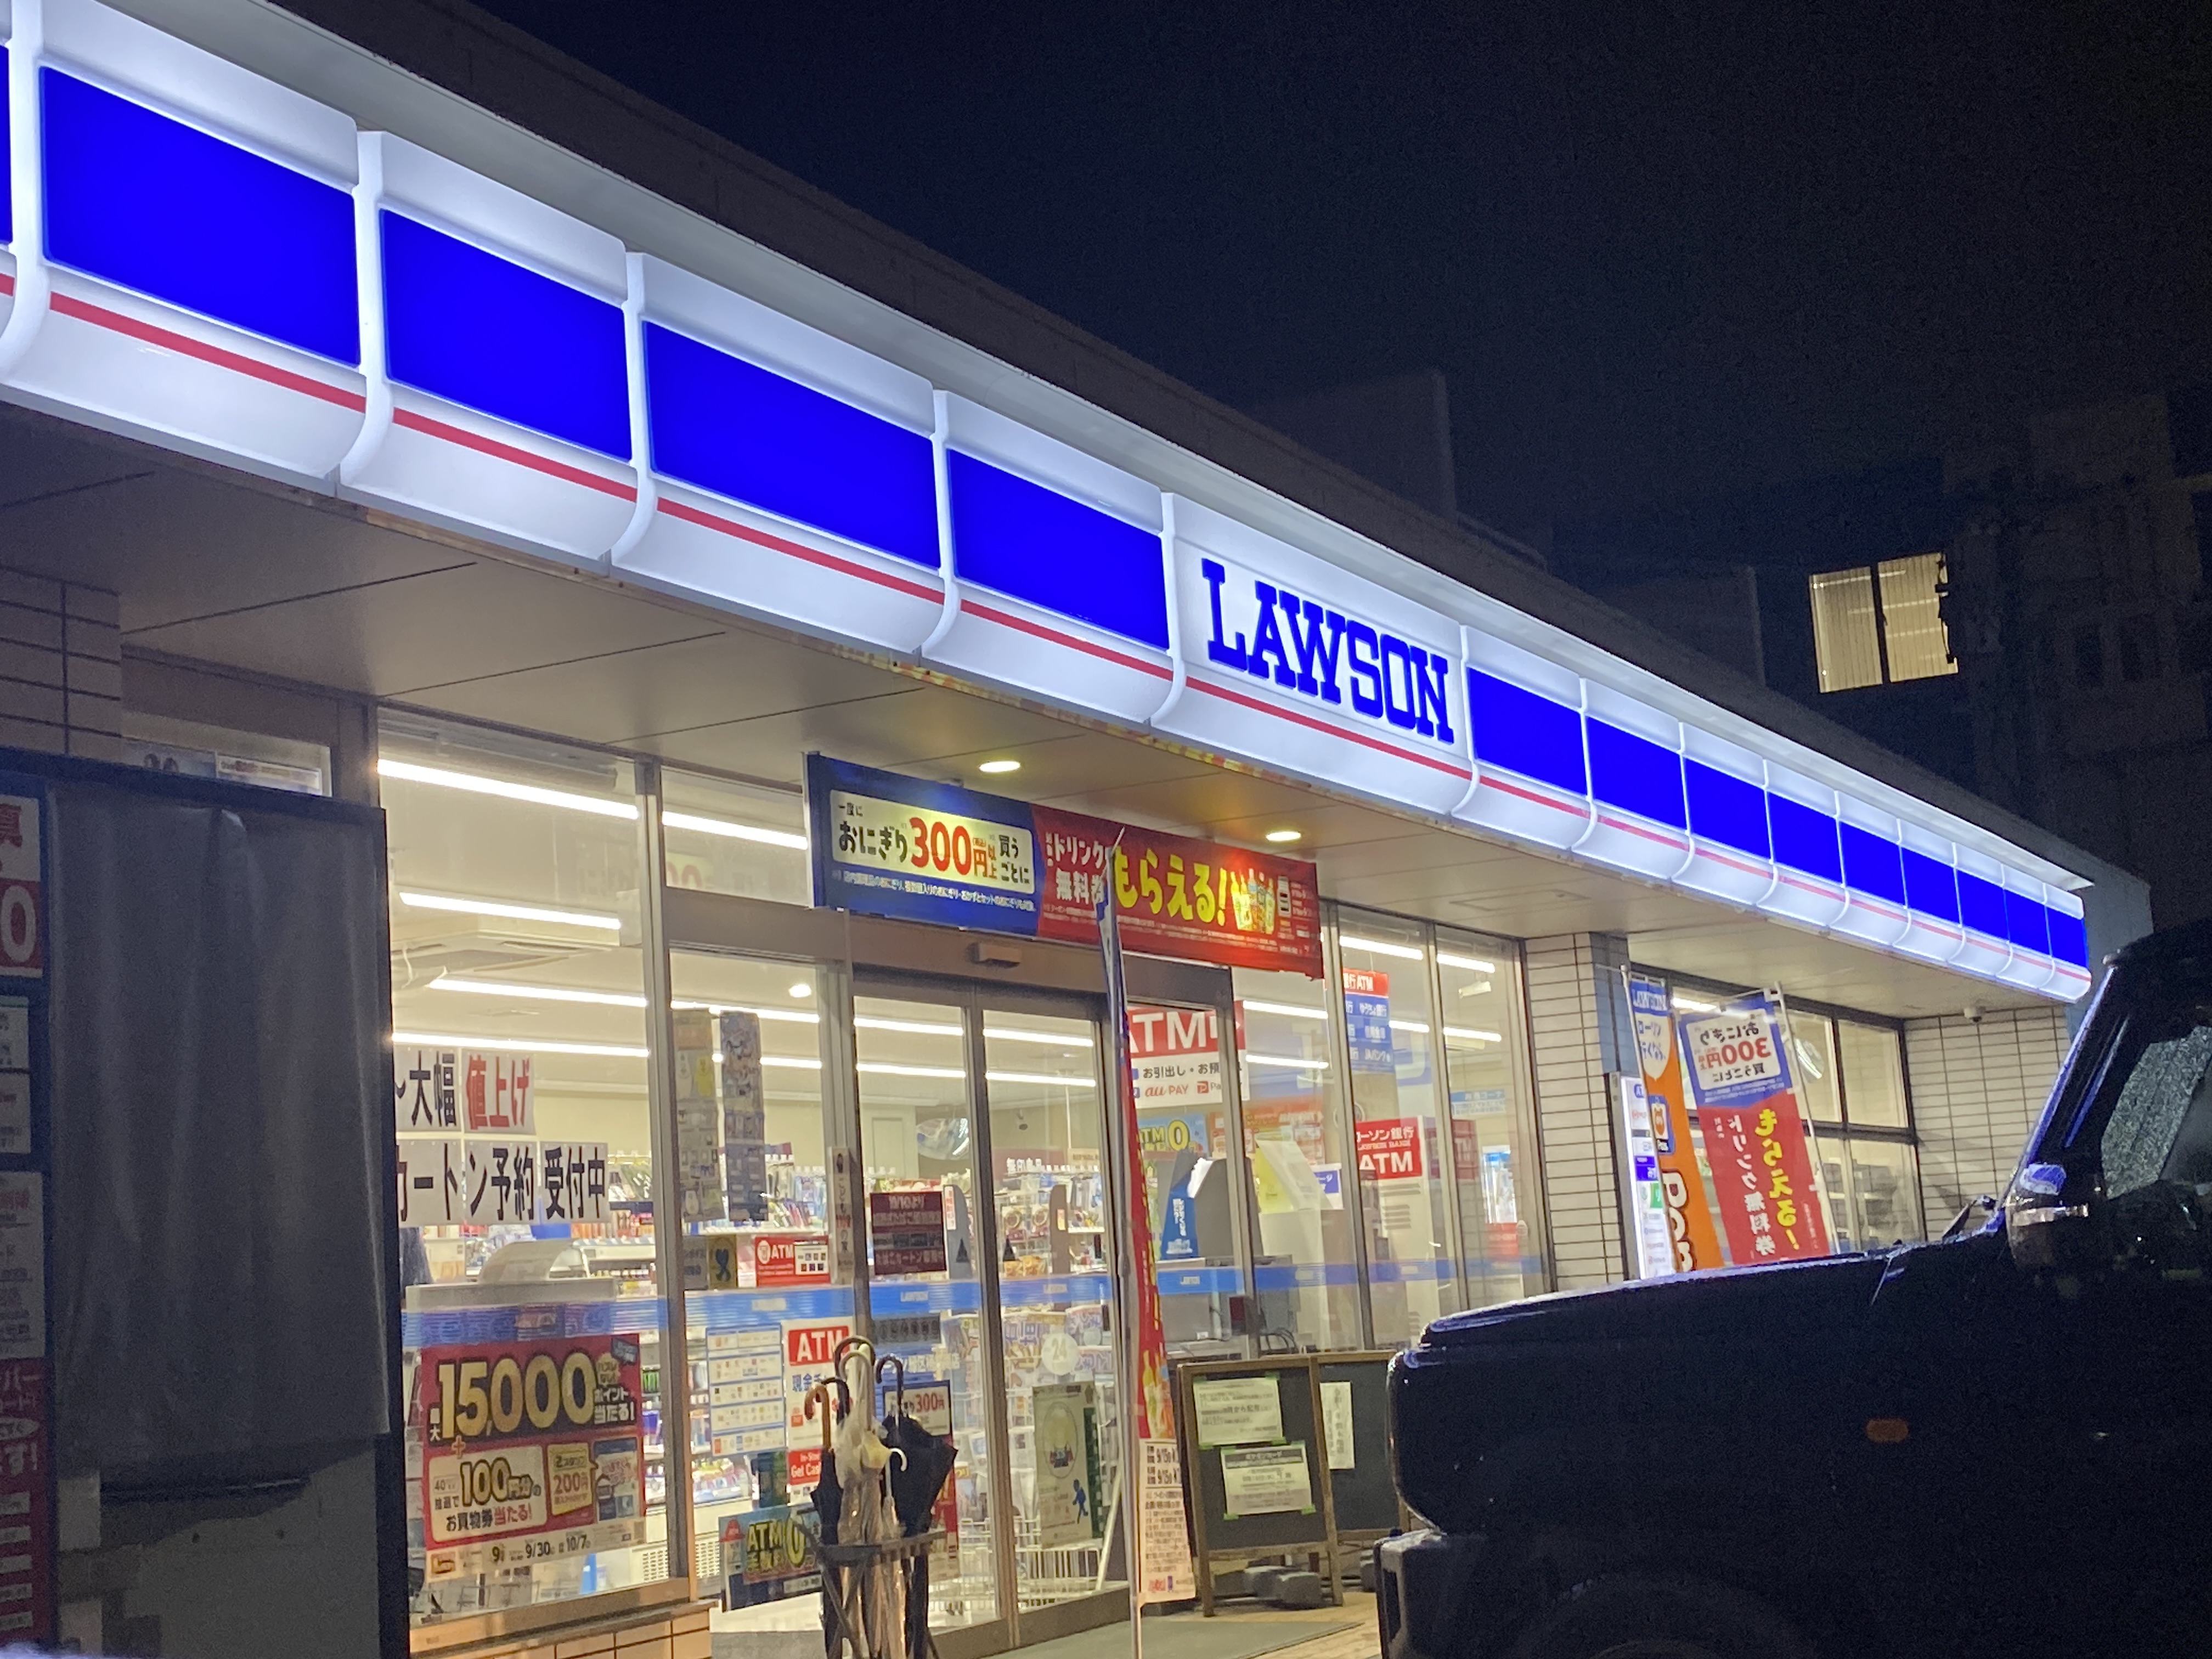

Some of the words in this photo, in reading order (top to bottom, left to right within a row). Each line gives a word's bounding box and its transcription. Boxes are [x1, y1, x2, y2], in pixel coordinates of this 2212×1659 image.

[1201, 558, 1454, 744] LAWSON
[839, 820, 909, 862] おにぎり
[998, 834, 1019, 859] 買う
[1054, 833, 1104, 869] ドリンク
[1001, 861, 1029, 884] ごとに
[1145, 1084, 1166, 1097] au
[1169, 1084, 1189, 1095] PAY
[1358, 1150, 1414, 1174] ATM
[797, 1329, 843, 1363] ATM
[439, 1352, 596, 1440] 15,000
